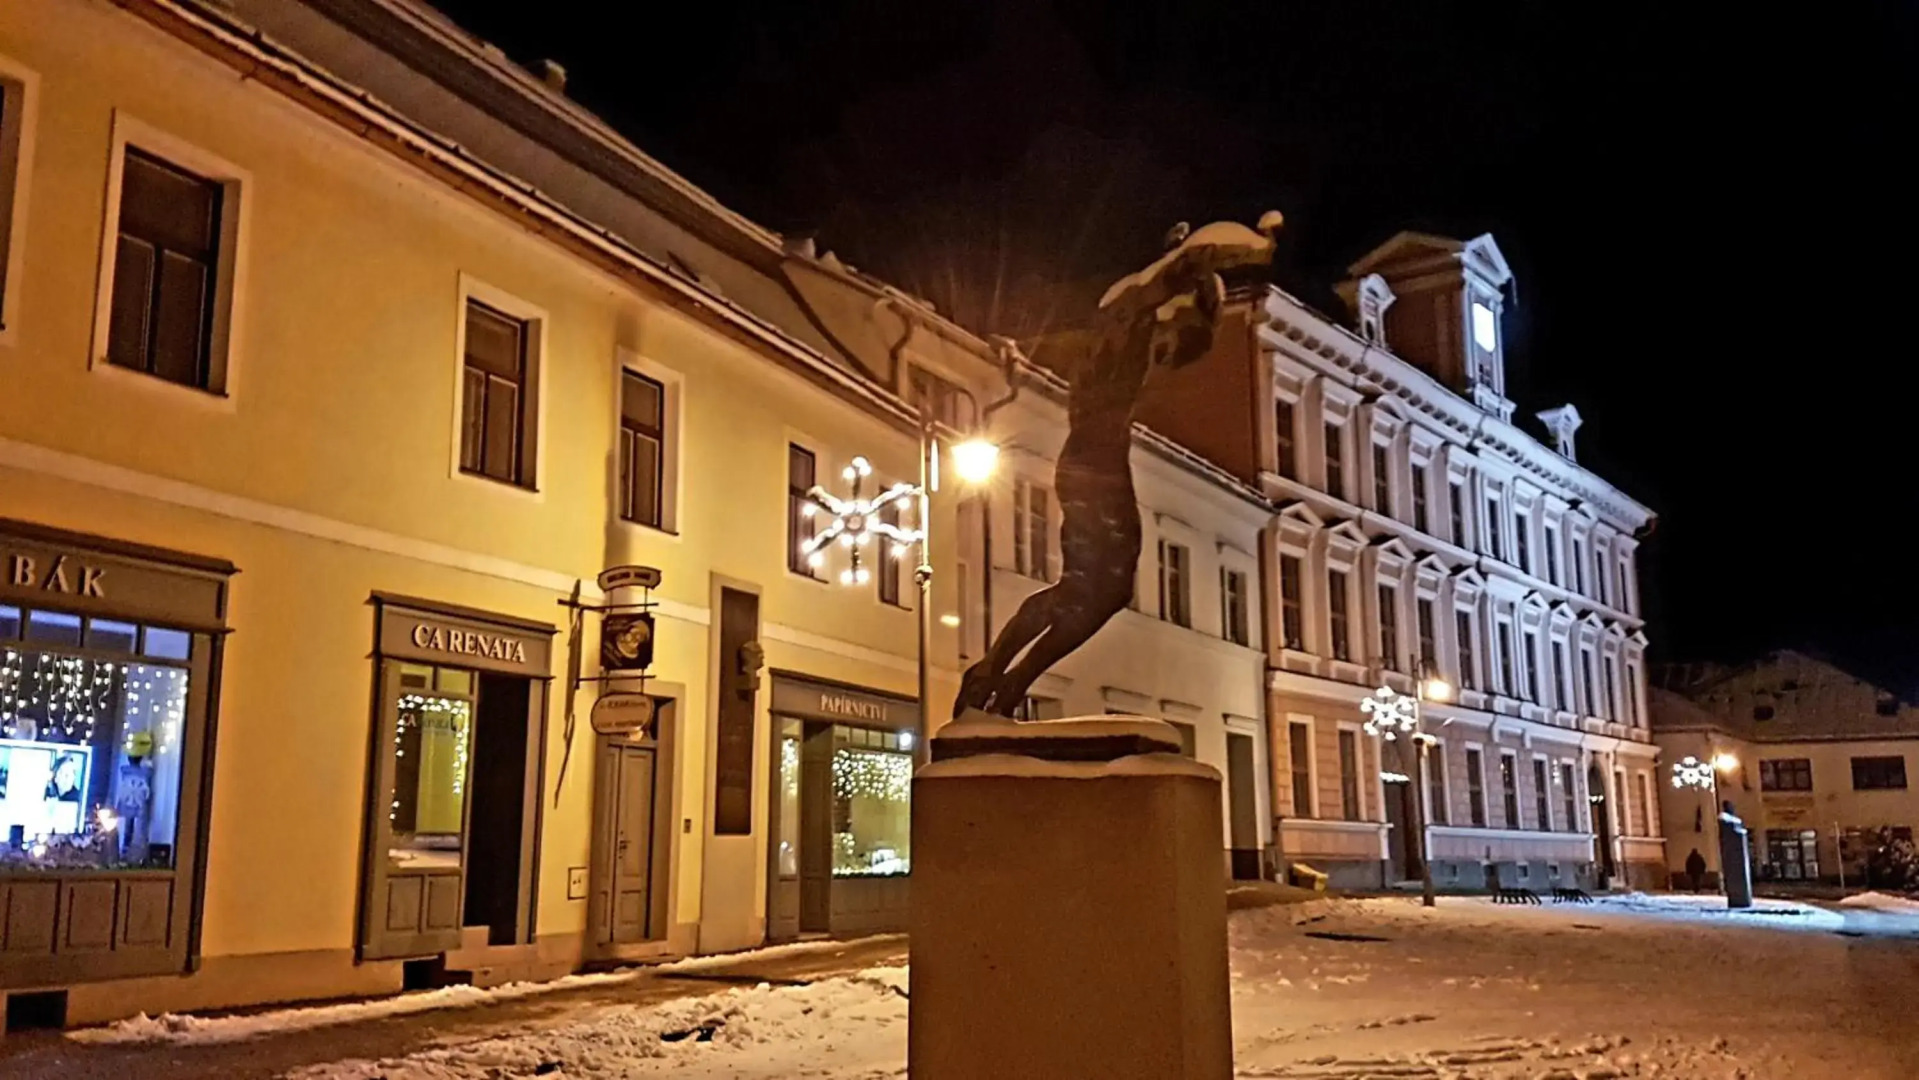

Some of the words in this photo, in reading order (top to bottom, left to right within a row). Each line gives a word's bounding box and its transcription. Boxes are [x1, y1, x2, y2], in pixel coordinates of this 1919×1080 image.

[13, 554, 106, 598] BÁK
[413, 623, 444, 650] CA
[448, 629, 526, 663] RENATA
[820, 694, 887, 721] PAPÍRNICTVÍ
